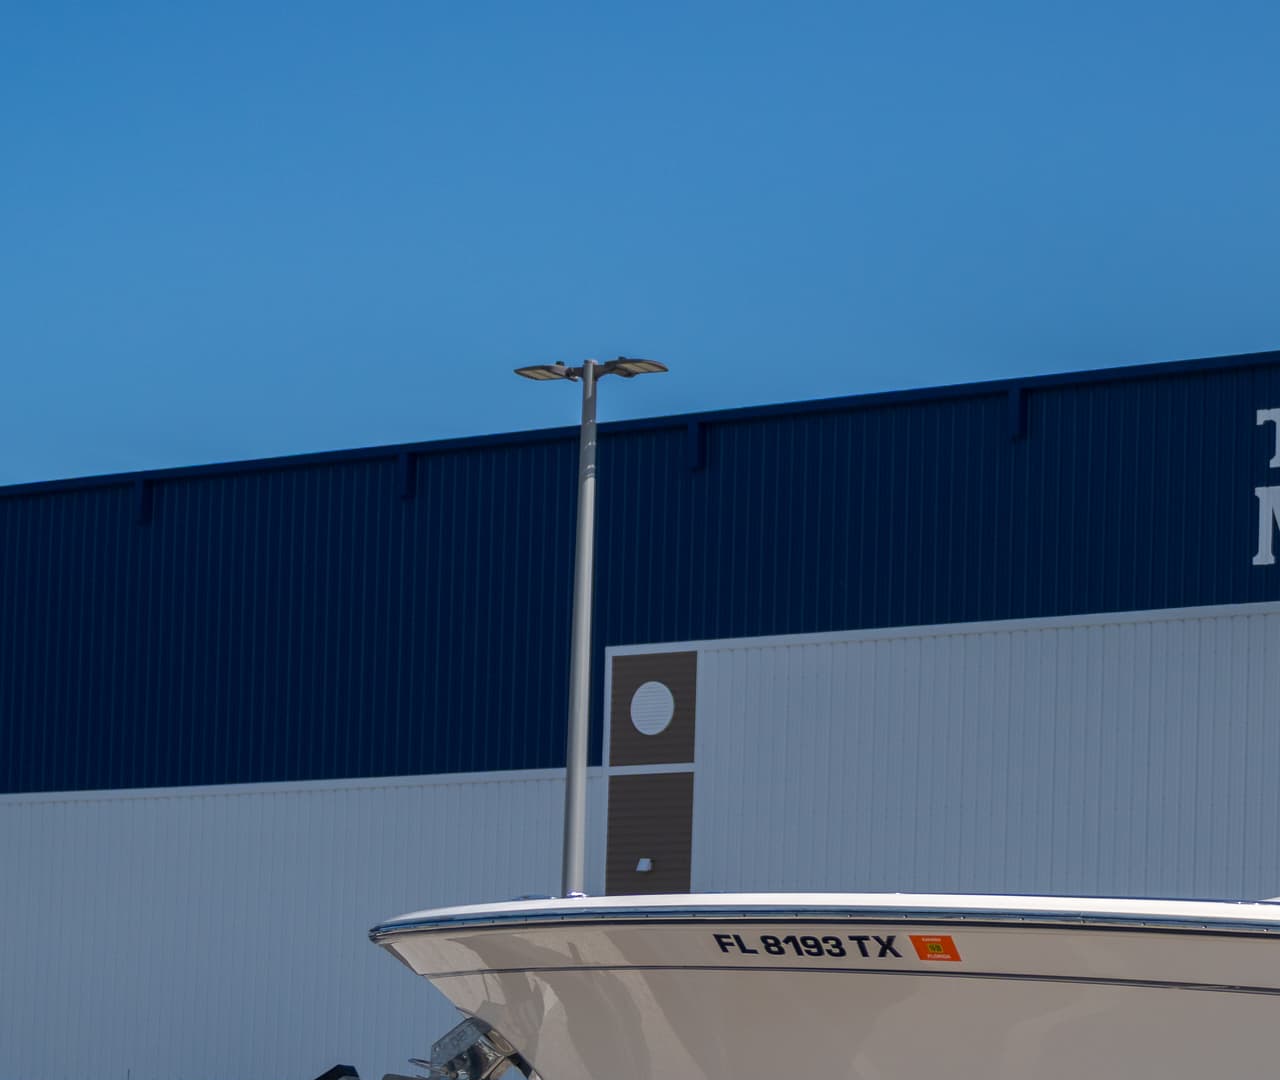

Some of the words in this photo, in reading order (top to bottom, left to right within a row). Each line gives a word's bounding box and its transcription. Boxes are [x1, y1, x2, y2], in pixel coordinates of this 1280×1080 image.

[713, 933, 759, 955] FL
[760, 935, 847, 957] 8193
[849, 935, 903, 958] TX
